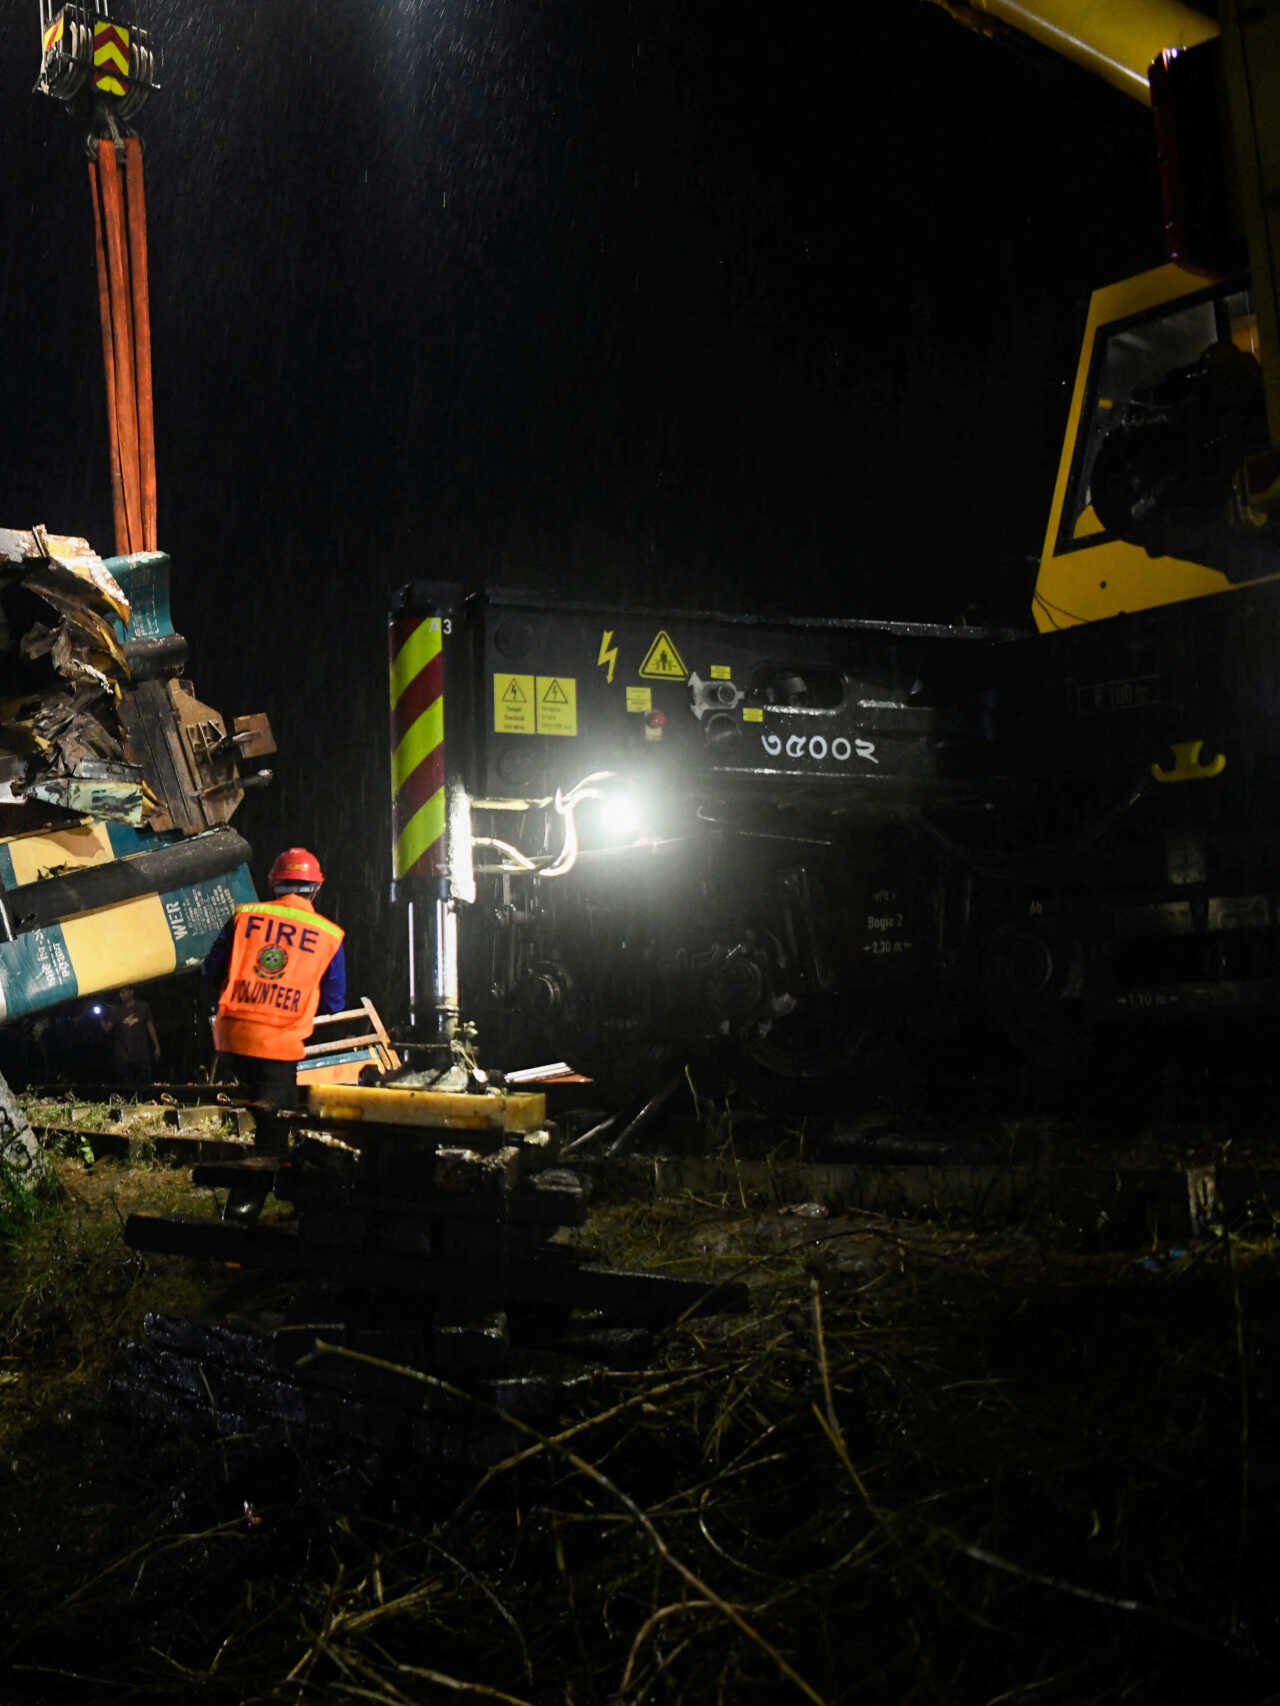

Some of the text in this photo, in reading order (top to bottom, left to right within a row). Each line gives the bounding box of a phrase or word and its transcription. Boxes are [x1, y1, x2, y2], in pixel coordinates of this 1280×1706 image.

[760, 734, 880, 764] ৩৫০০২
[166, 901, 188, 941] WER
[243, 915, 320, 954] FIRE
[229, 978, 302, 1013] VOLUNTEER
